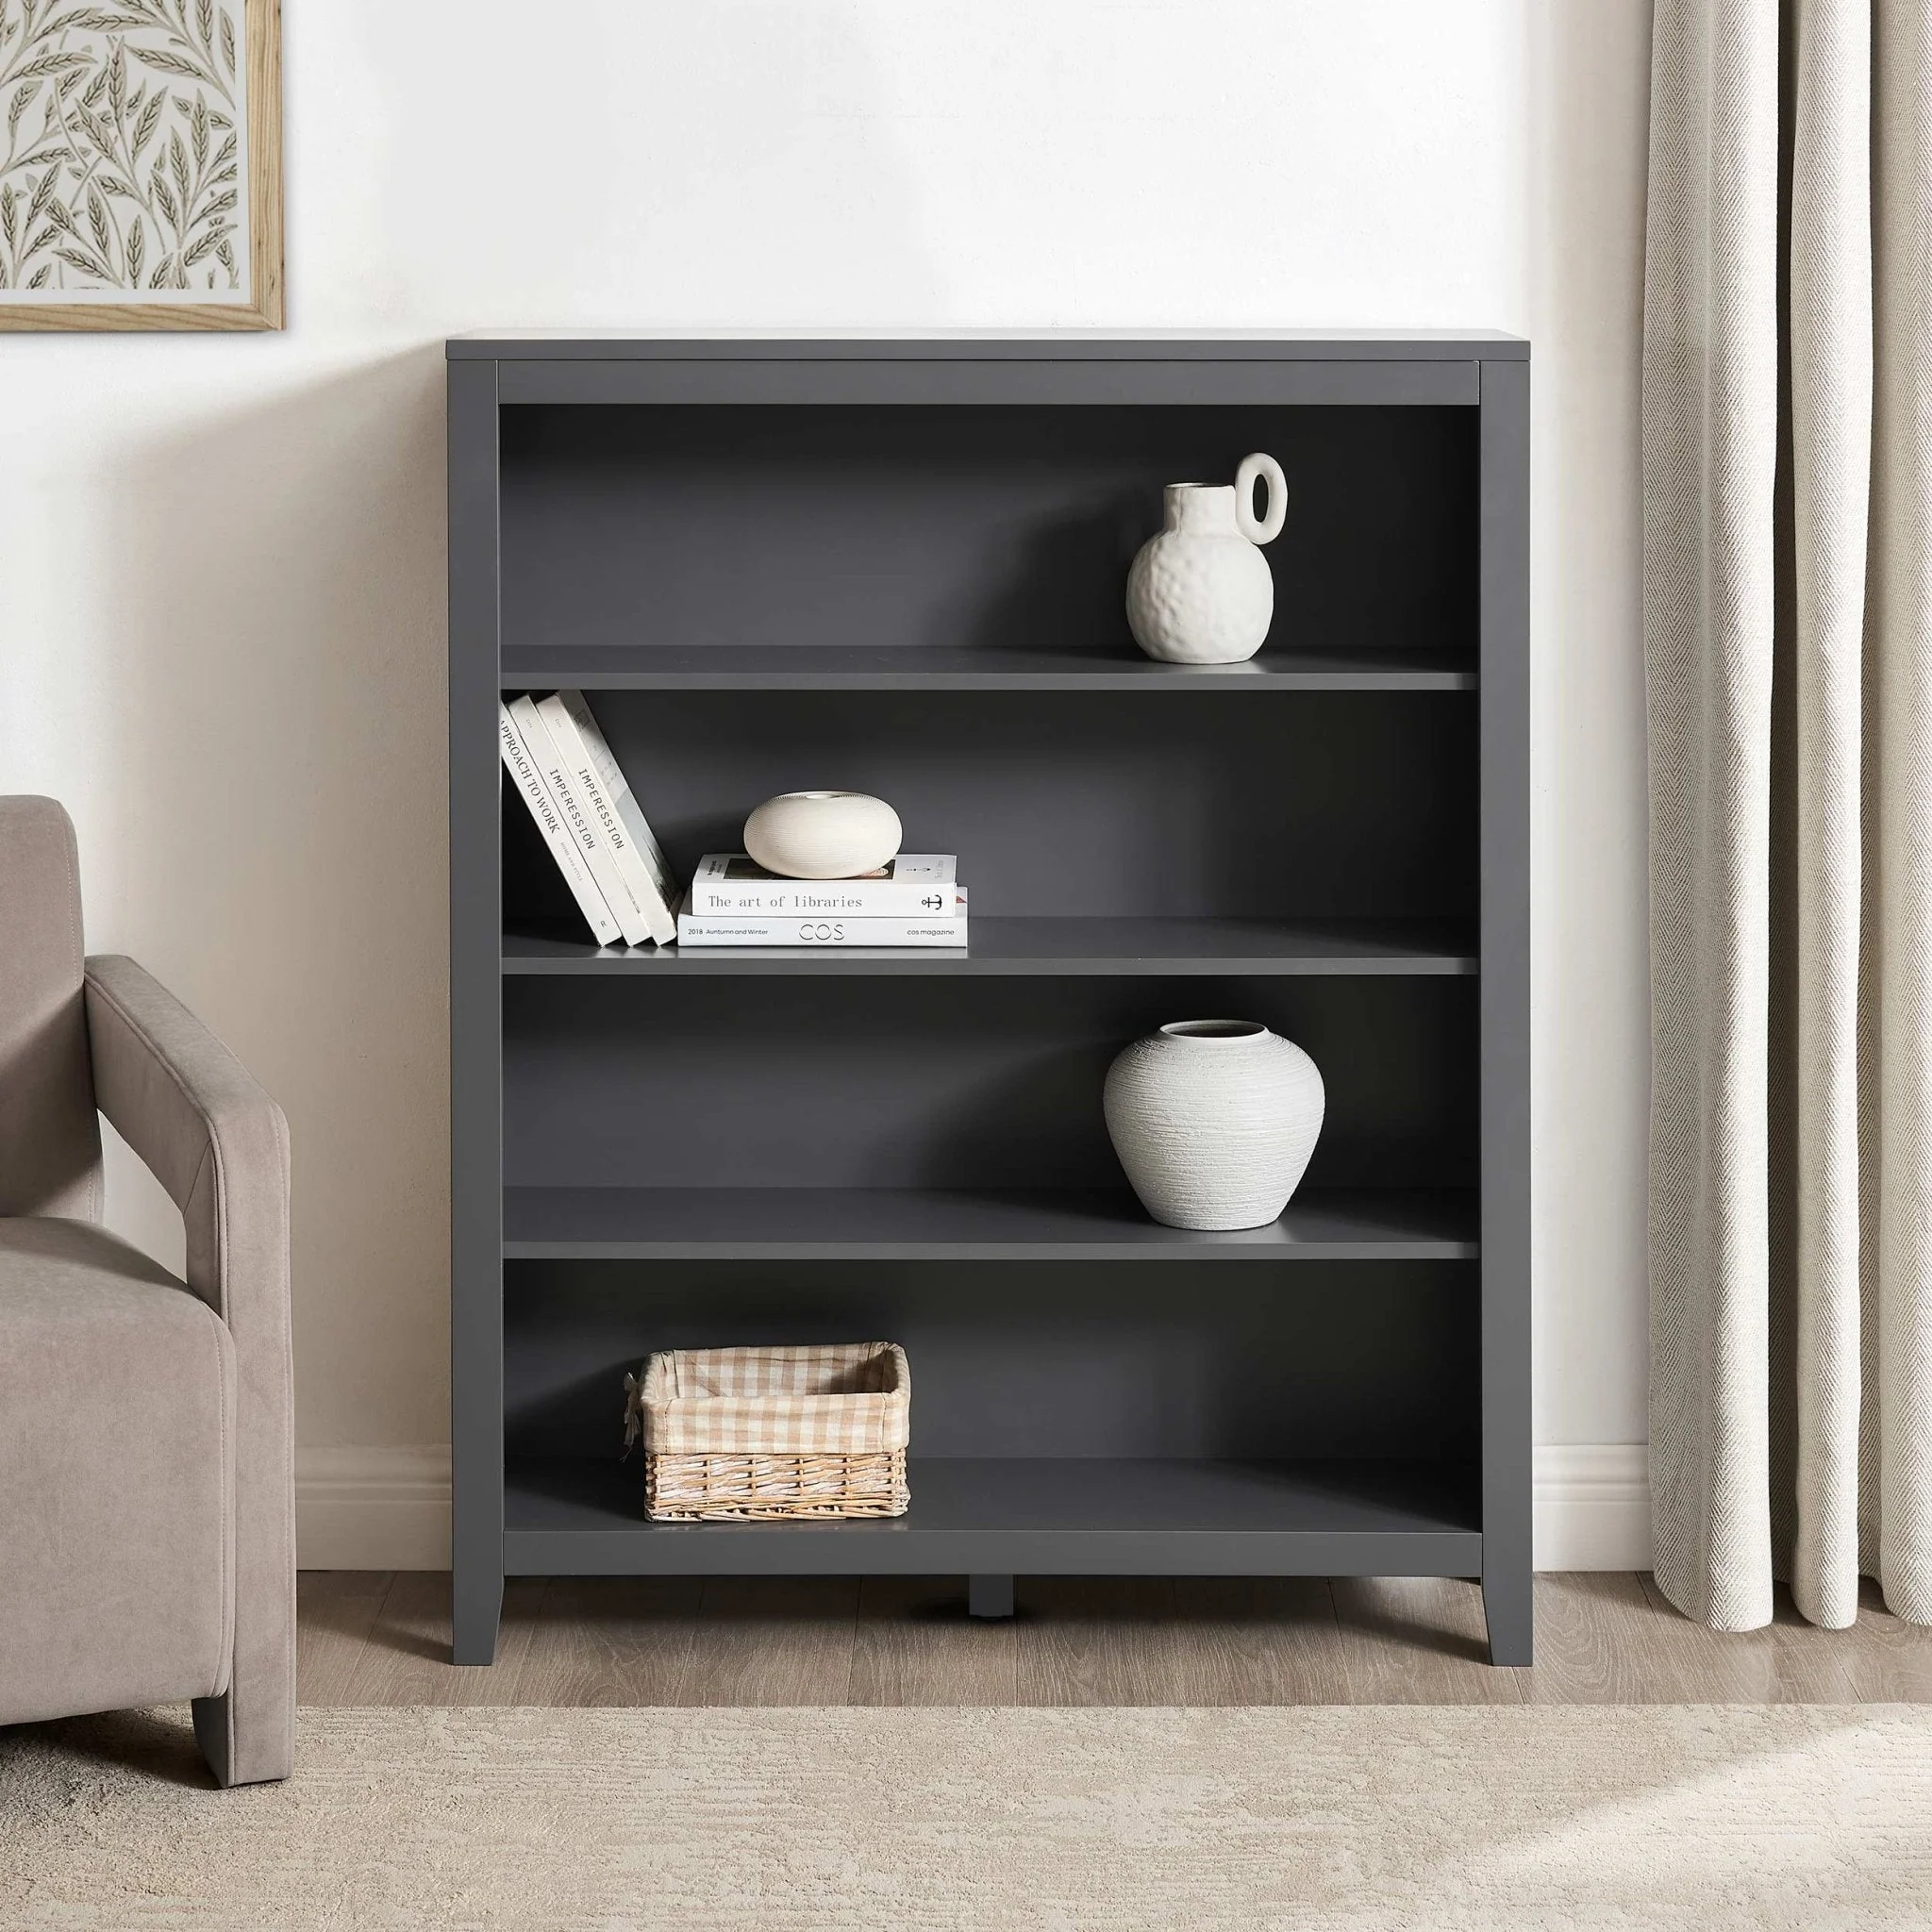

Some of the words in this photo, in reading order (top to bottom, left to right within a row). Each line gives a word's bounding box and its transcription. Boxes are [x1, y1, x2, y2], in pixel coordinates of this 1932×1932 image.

[527, 778, 541, 797] TO
[537, 796, 560, 834] WORK
[550, 769, 595, 849] IMPERESSION
[578, 769, 624, 849] IMPERESSION
[708, 895, 731, 908] The
[740, 897, 761, 908] art
[770, 895, 786, 908] of
[794, 895, 863, 908] libraries
[799, 924, 845, 941] COS
